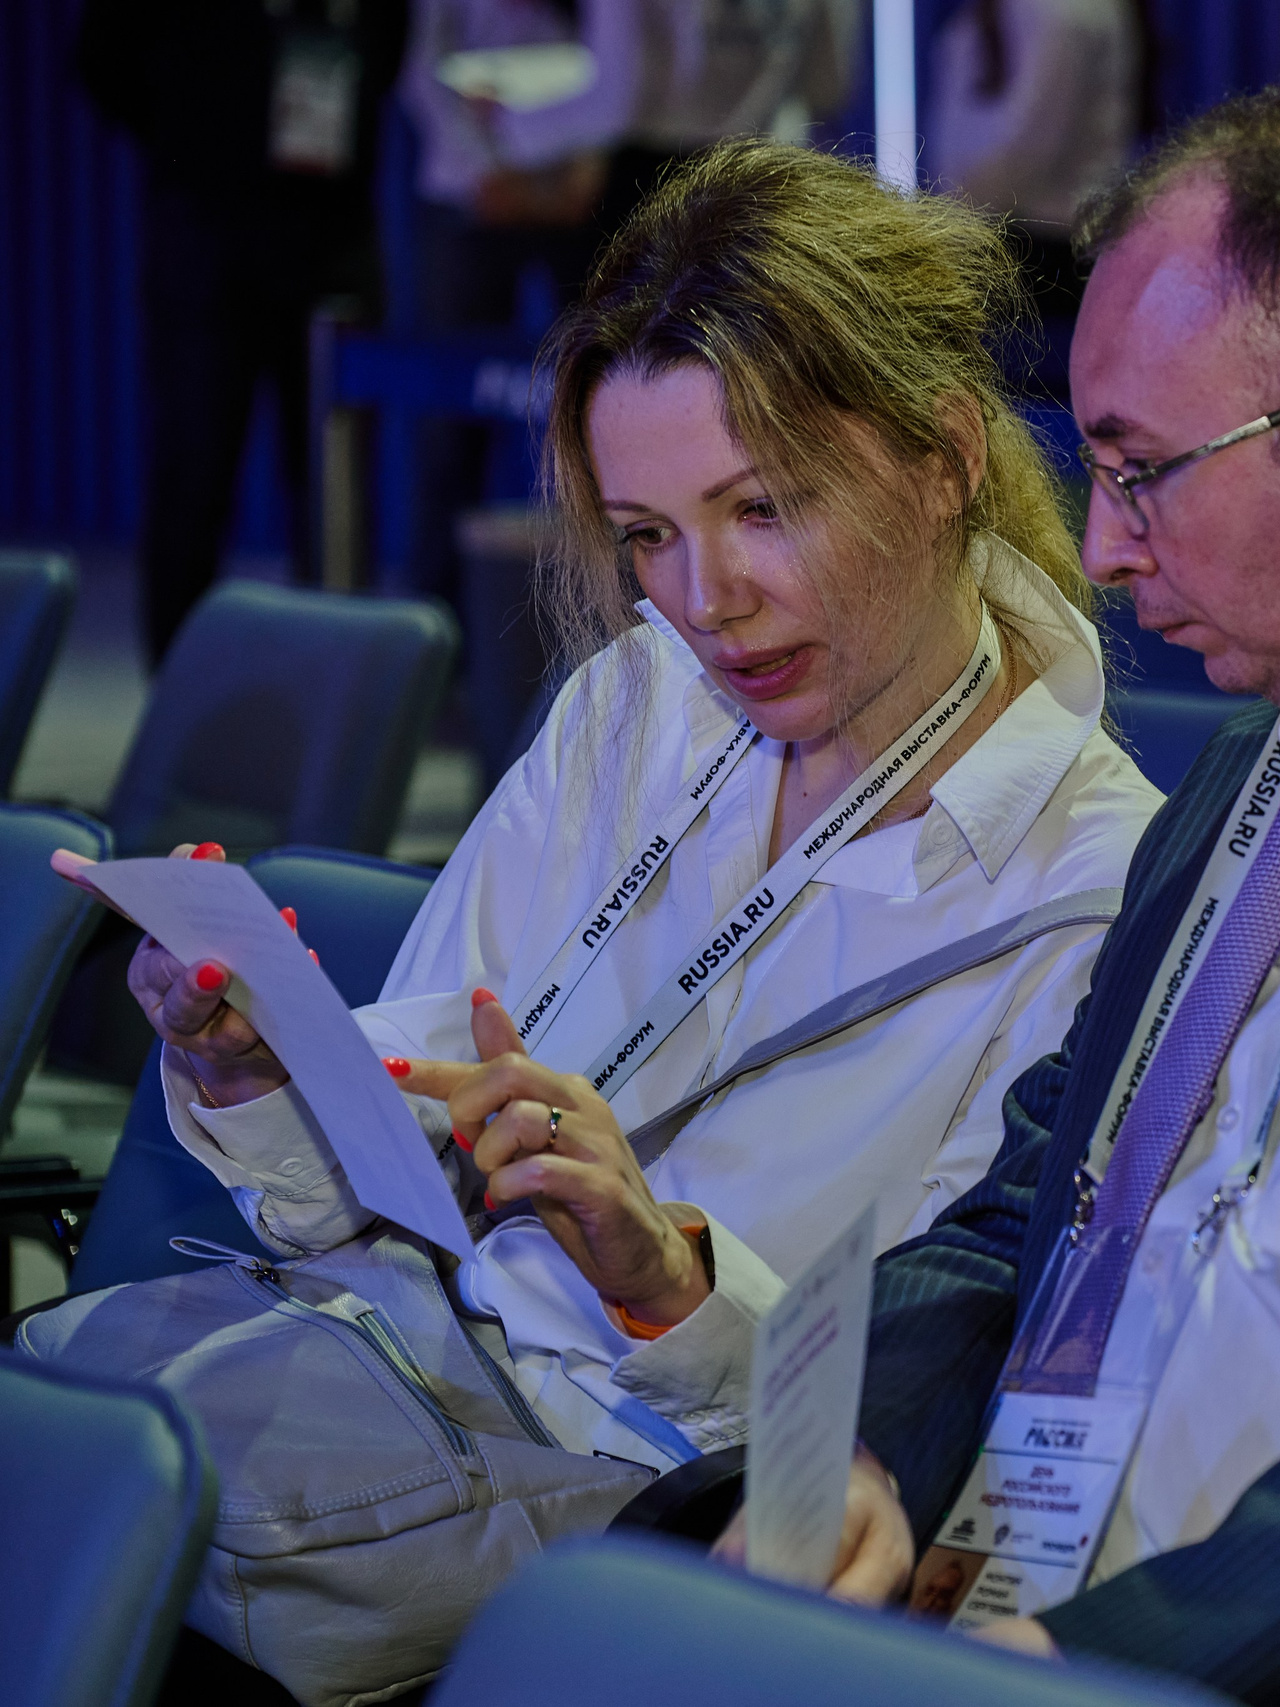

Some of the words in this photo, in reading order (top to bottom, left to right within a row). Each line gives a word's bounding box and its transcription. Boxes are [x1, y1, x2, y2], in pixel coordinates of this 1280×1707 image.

[803, 757, 904, 859] МЕЖДУНАРОДНАЯ
[900, 653, 991, 762] ВЫСТАВКА-ФОРУМ
[582, 835, 669, 949] RUSSIA.RU
[678, 888, 775, 995] RUSSIA.RU
[518, 983, 561, 1039] МЕЖДУН
[1163, 897, 1219, 1016] МЕЖДУНАРОДНАЯ
